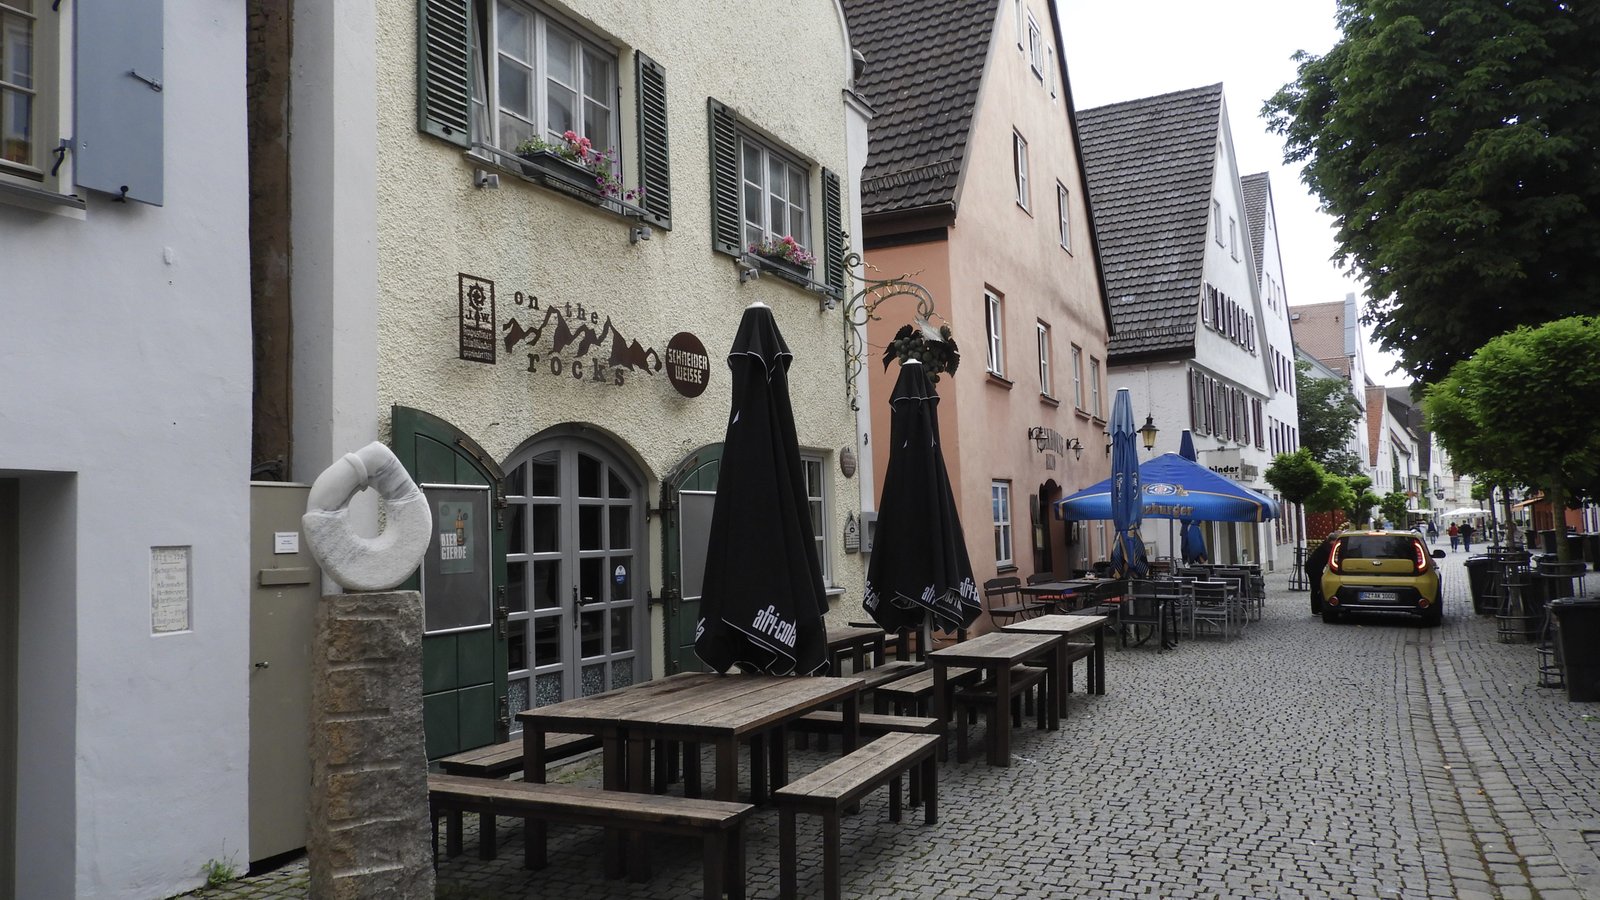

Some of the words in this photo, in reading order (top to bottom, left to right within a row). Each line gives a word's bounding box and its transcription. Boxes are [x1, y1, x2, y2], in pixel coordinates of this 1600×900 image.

[514, 291, 539, 310] on
[565, 302, 598, 325] the
[527, 353, 624, 386] rocks
[668, 348, 708, 370] SCHNEIDER
[675, 365, 702, 384] WEISSE
[863, 432, 868, 446] 3
[441, 546, 467, 560] GIERDE
[752, 604, 797, 648] afri-cola
